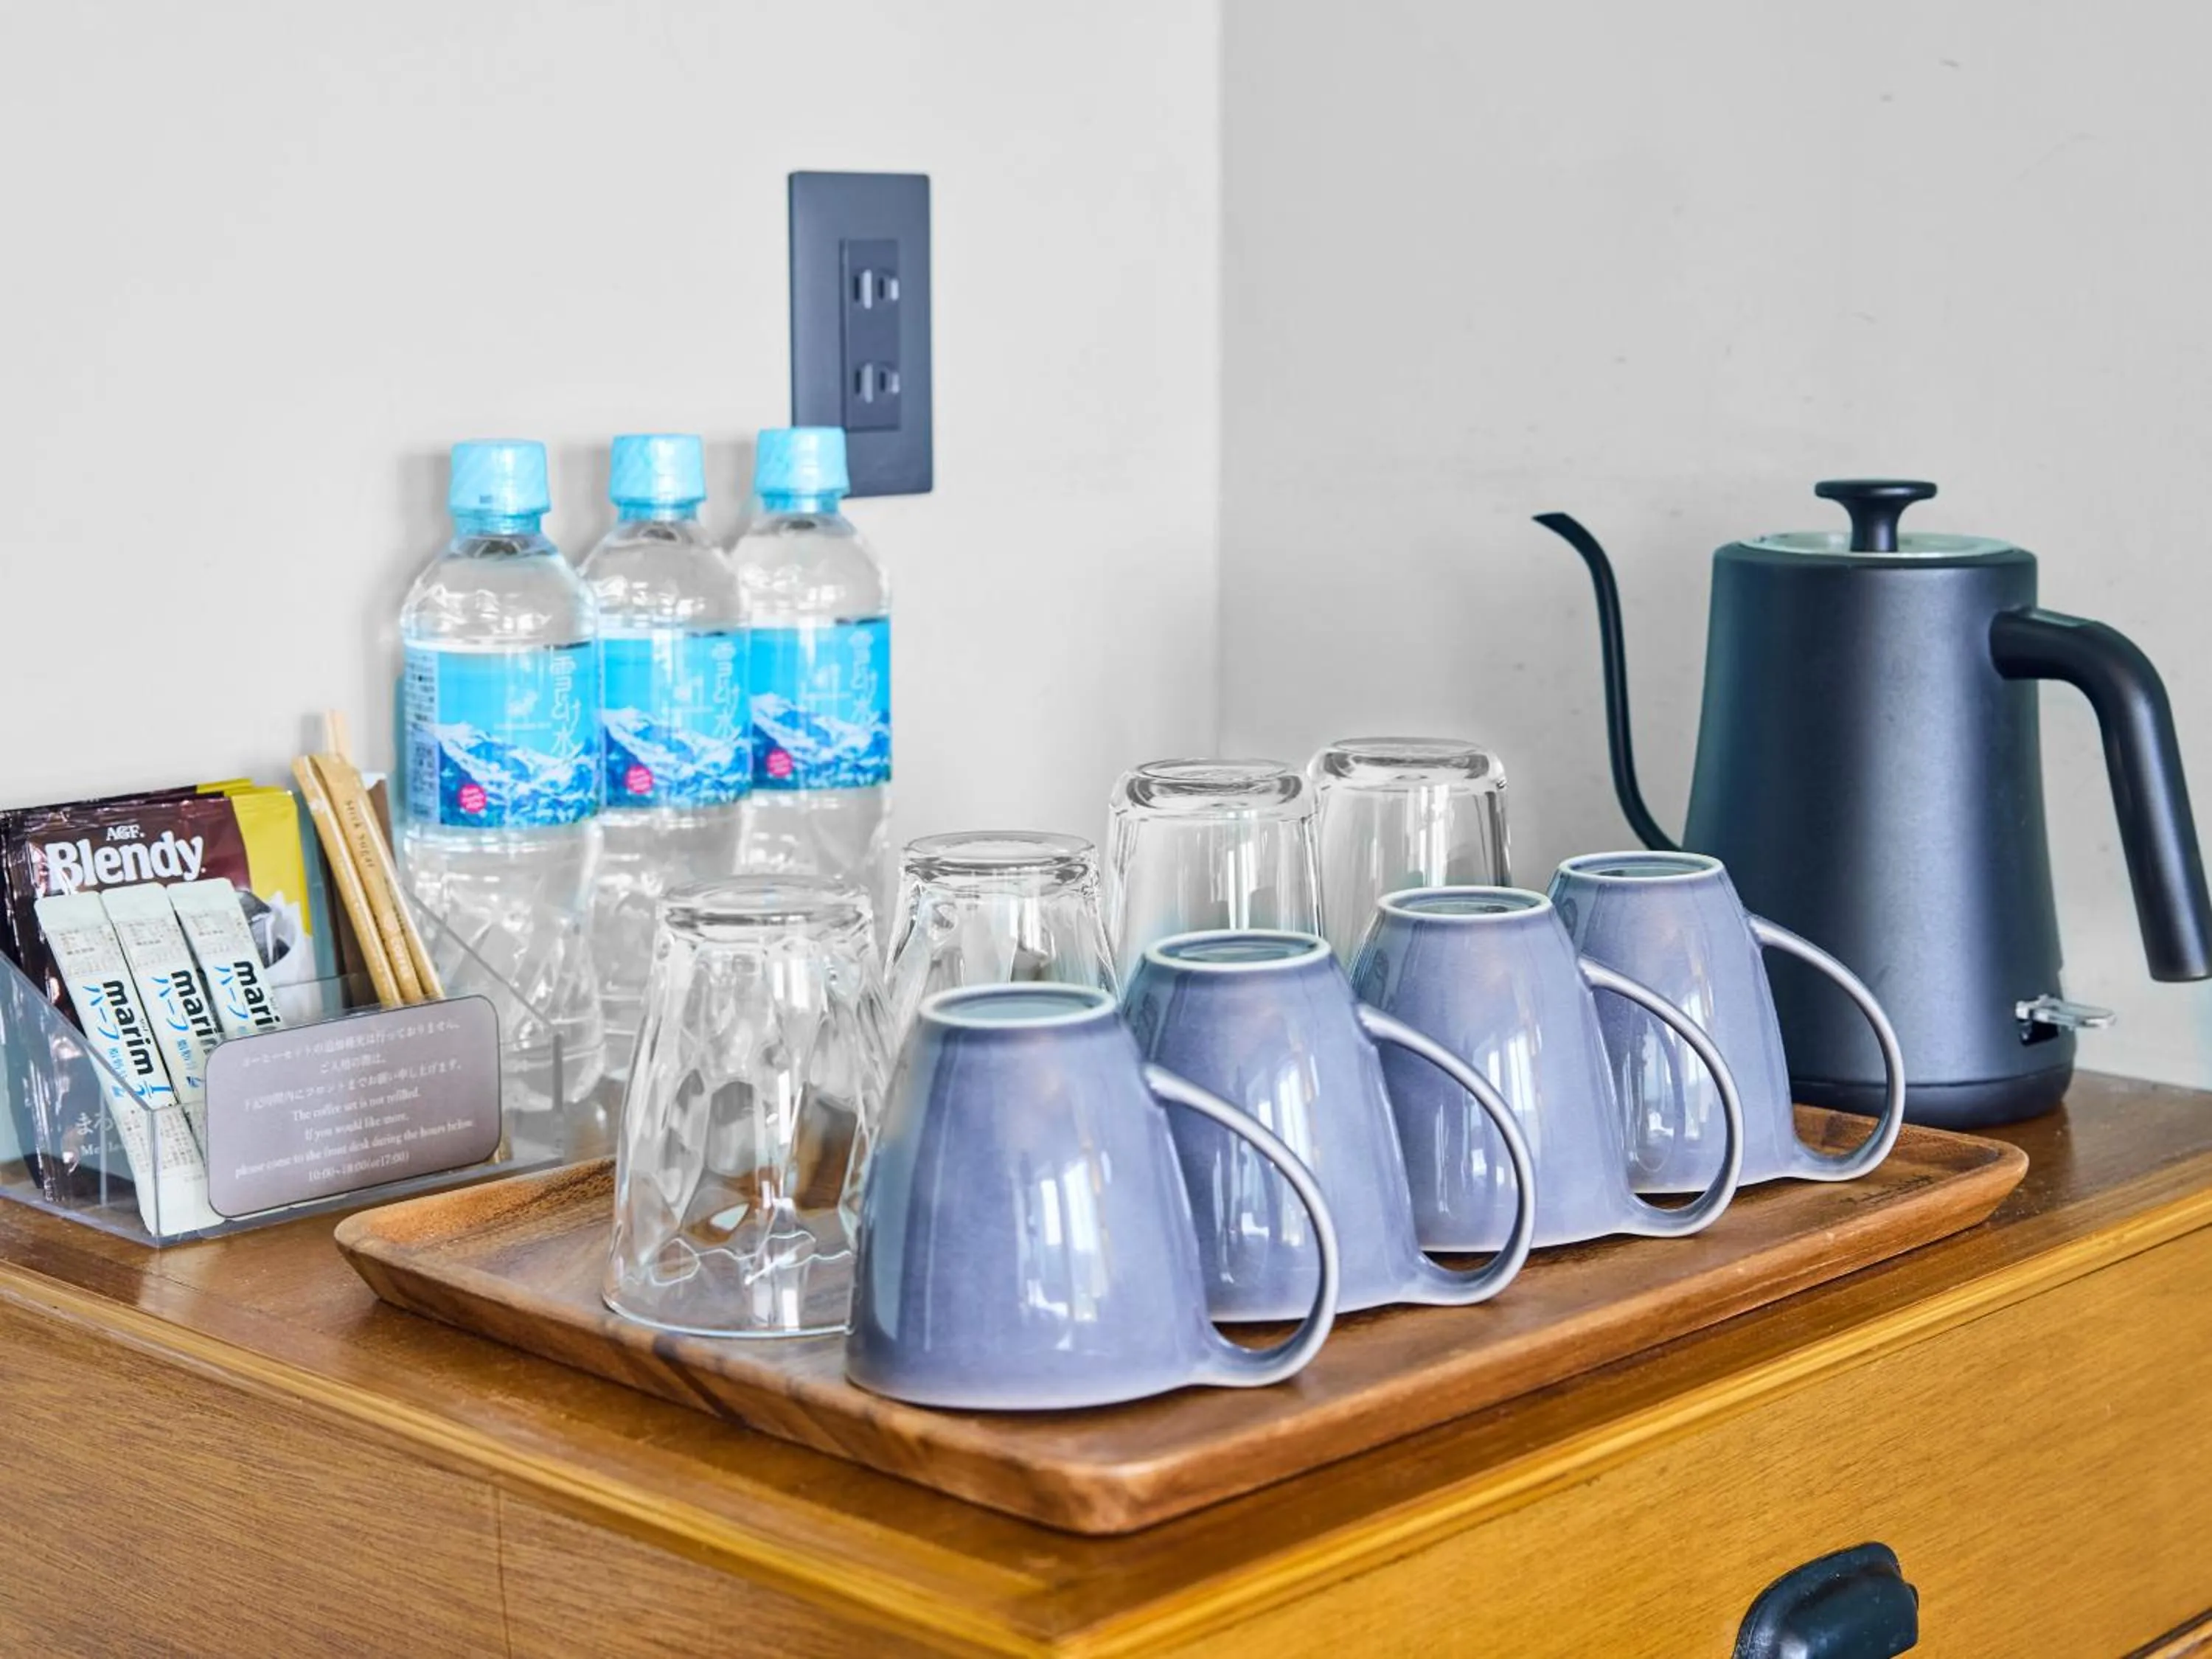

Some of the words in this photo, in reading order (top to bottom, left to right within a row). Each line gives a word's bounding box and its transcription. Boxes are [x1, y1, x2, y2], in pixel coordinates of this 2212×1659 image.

[44, 830, 204, 894] Blendy
[83, 986, 119, 1040] ハーフ
[151, 977, 189, 1031] ハーフ
[214, 966, 248, 1019] ハーフ
[234, 961, 280, 1030] mari
[102, 980, 154, 1076] marim
[293, 1108, 311, 1121] The
[313, 1103, 341, 1118] coffee
[344, 1100, 358, 1111] set
[369, 1096, 384, 1107] not
[305, 1127, 313, 1141] If
[314, 1128, 333, 1142] you
[335, 1119, 363, 1133] would
[364, 1117, 381, 1129] like
[235, 1164, 264, 1179] please
[266, 1158, 291, 1170] come
[293, 1154, 305, 1164] to
[305, 1150, 322, 1162] the
[323, 1145, 347, 1158] front
[349, 1138, 370, 1152] desk
[372, 1133, 403, 1150] during
[403, 1130, 419, 1141] the
[420, 1124, 446, 1138] hours
